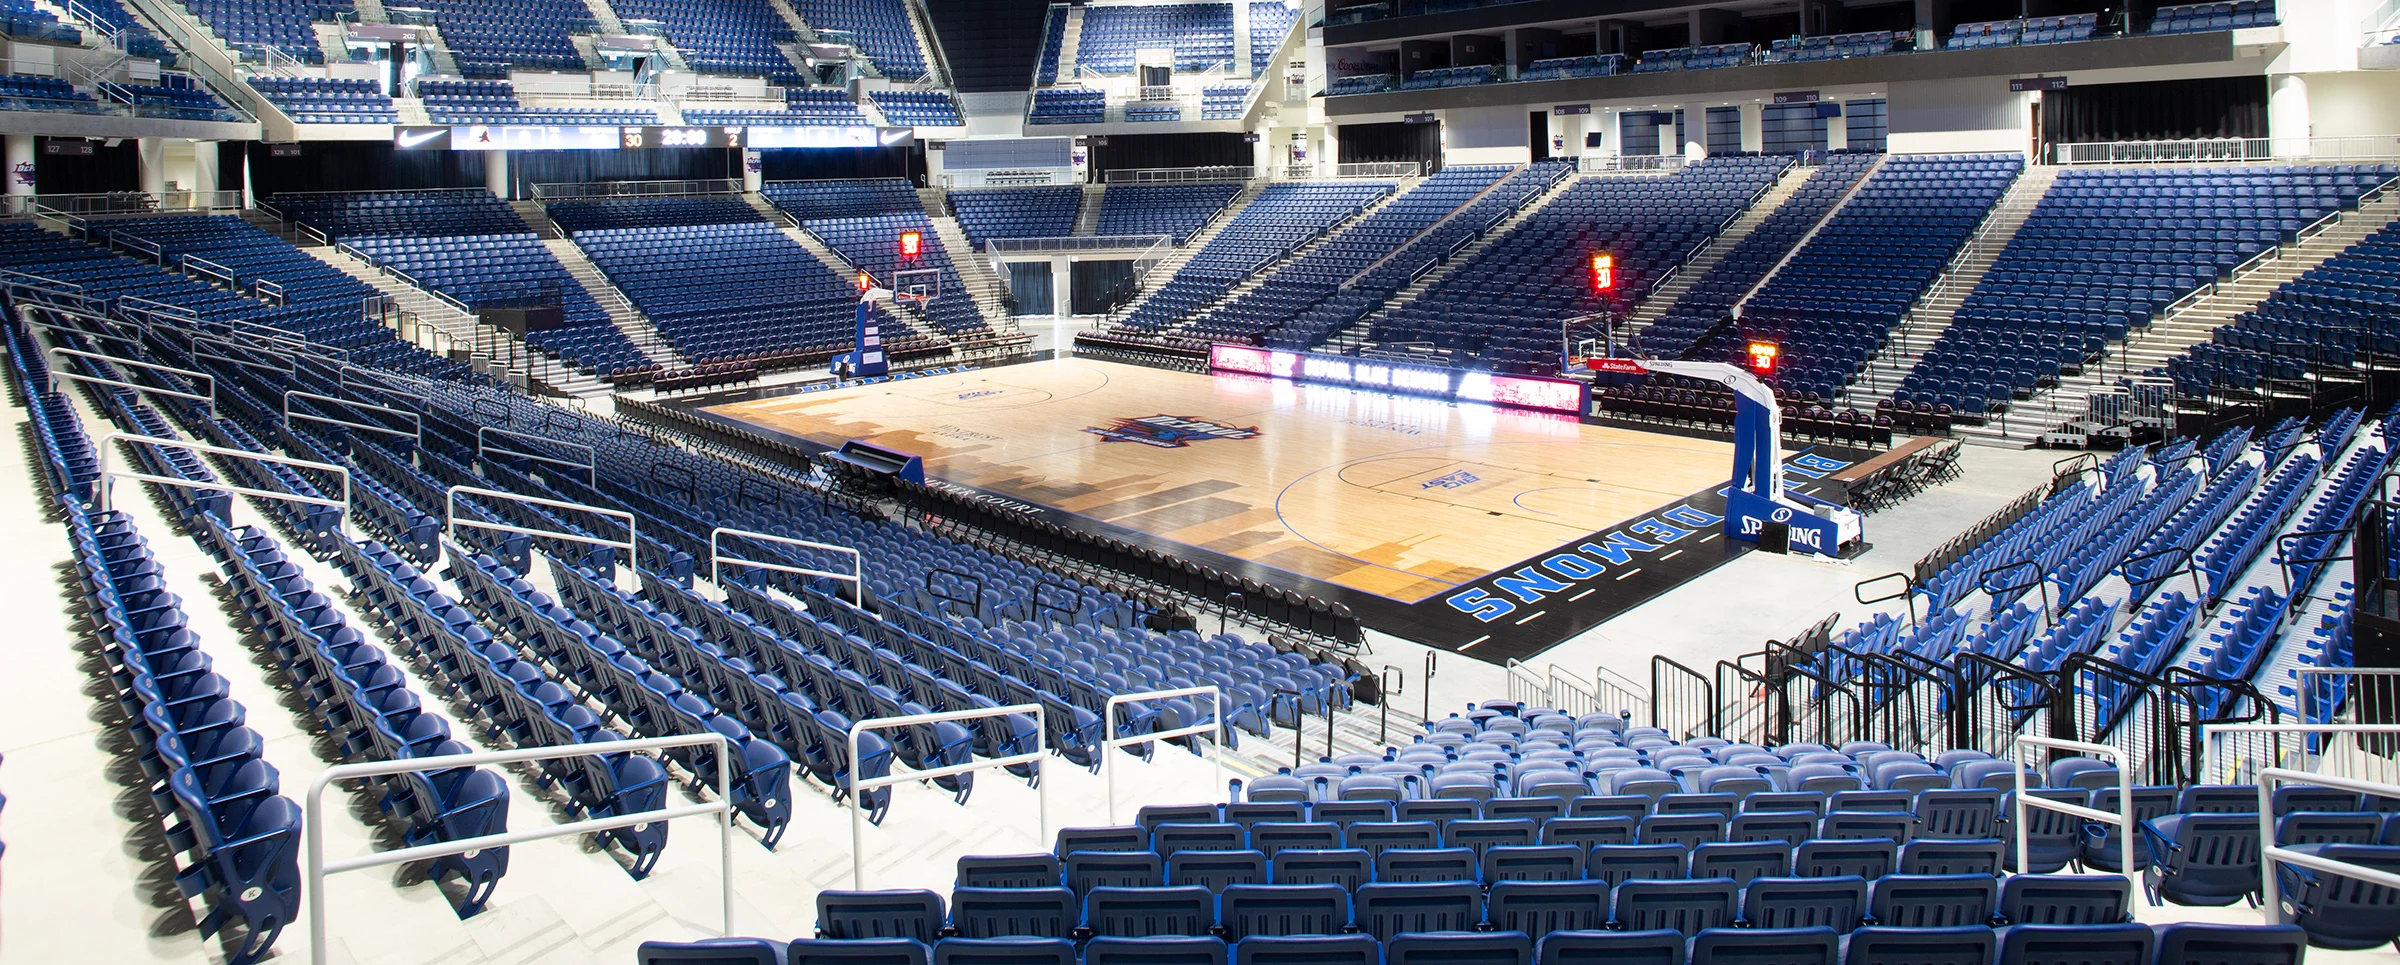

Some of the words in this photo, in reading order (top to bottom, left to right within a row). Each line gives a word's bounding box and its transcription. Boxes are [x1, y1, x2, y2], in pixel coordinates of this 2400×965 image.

[2011, 83, 2023, 91] 111
[2051, 80, 2065, 88] 112
[1774, 95, 1788, 103] 109
[1806, 94, 1818, 102] 110
[625, 134, 643, 147] 30
[662, 128, 707, 146] 20:00
[728, 134, 738, 147] 2
[48, 145, 60, 153] 127
[80, 146, 93, 154] 128
[1597, 267, 1611, 289] 30
[1756, 356, 1770, 369] 30
[975, 494, 1045, 515] COURT
[1740, 515, 1822, 550] SPING
[1445, 503, 1727, 624] DEMONS
